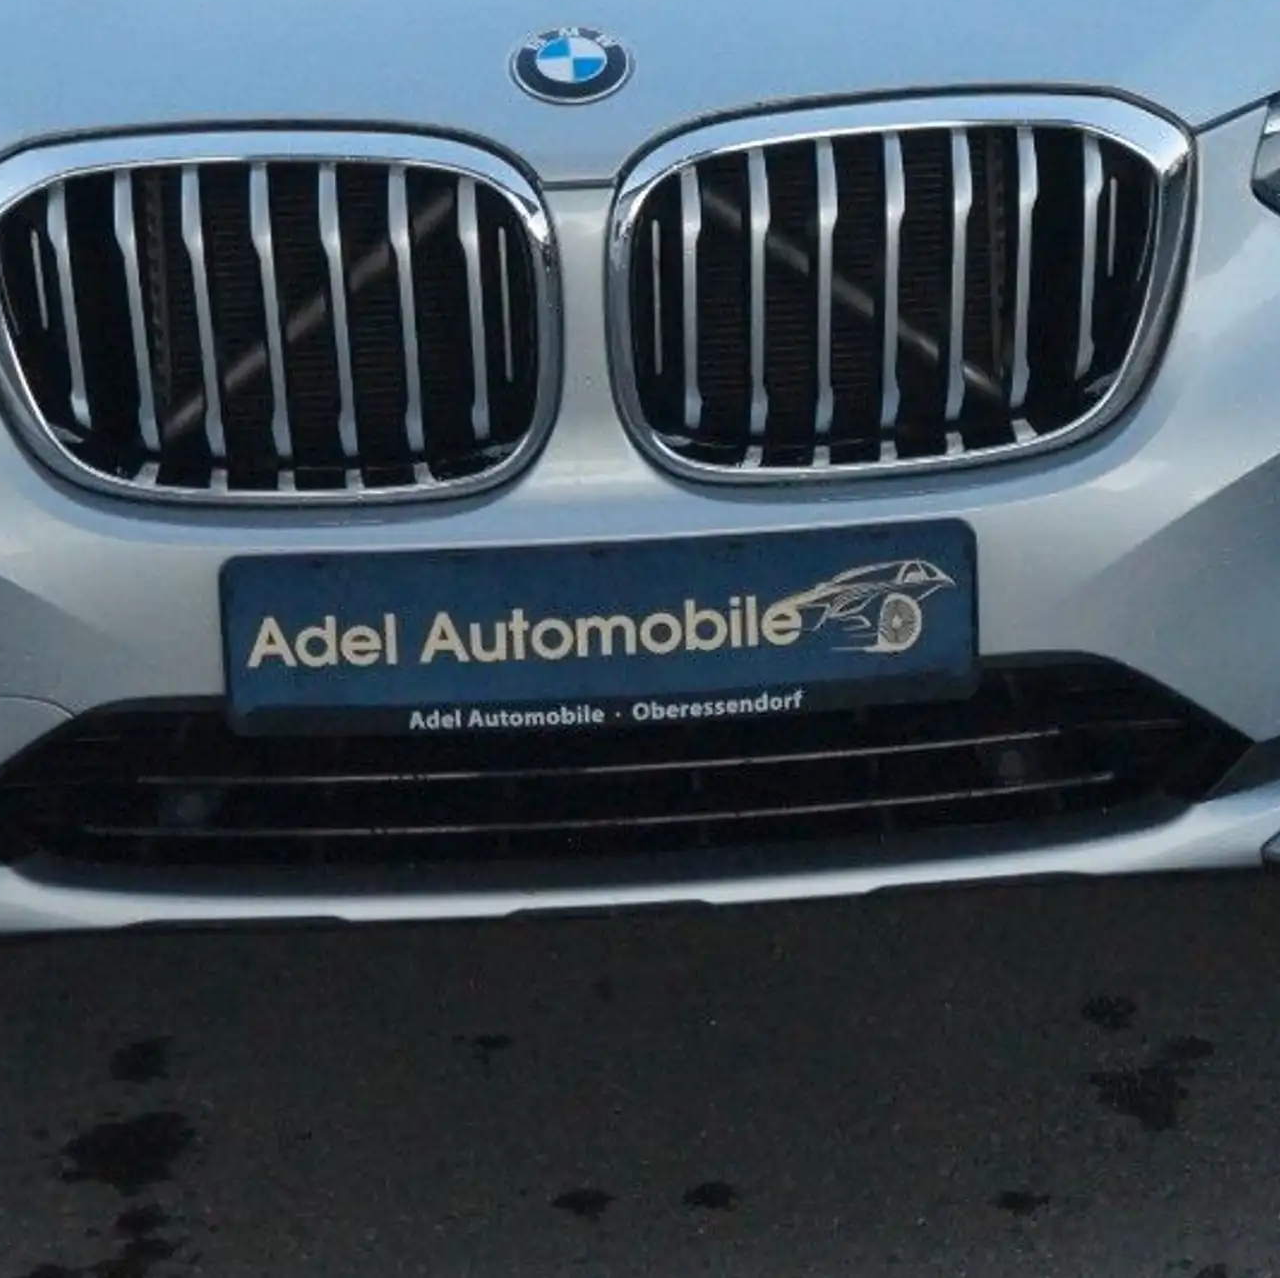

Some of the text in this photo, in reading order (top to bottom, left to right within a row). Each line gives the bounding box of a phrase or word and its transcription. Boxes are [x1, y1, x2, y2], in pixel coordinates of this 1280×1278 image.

[247, 595, 802, 667] Adel Automobile
[410, 690, 803, 730] Adel Automobile Oberessendorf
